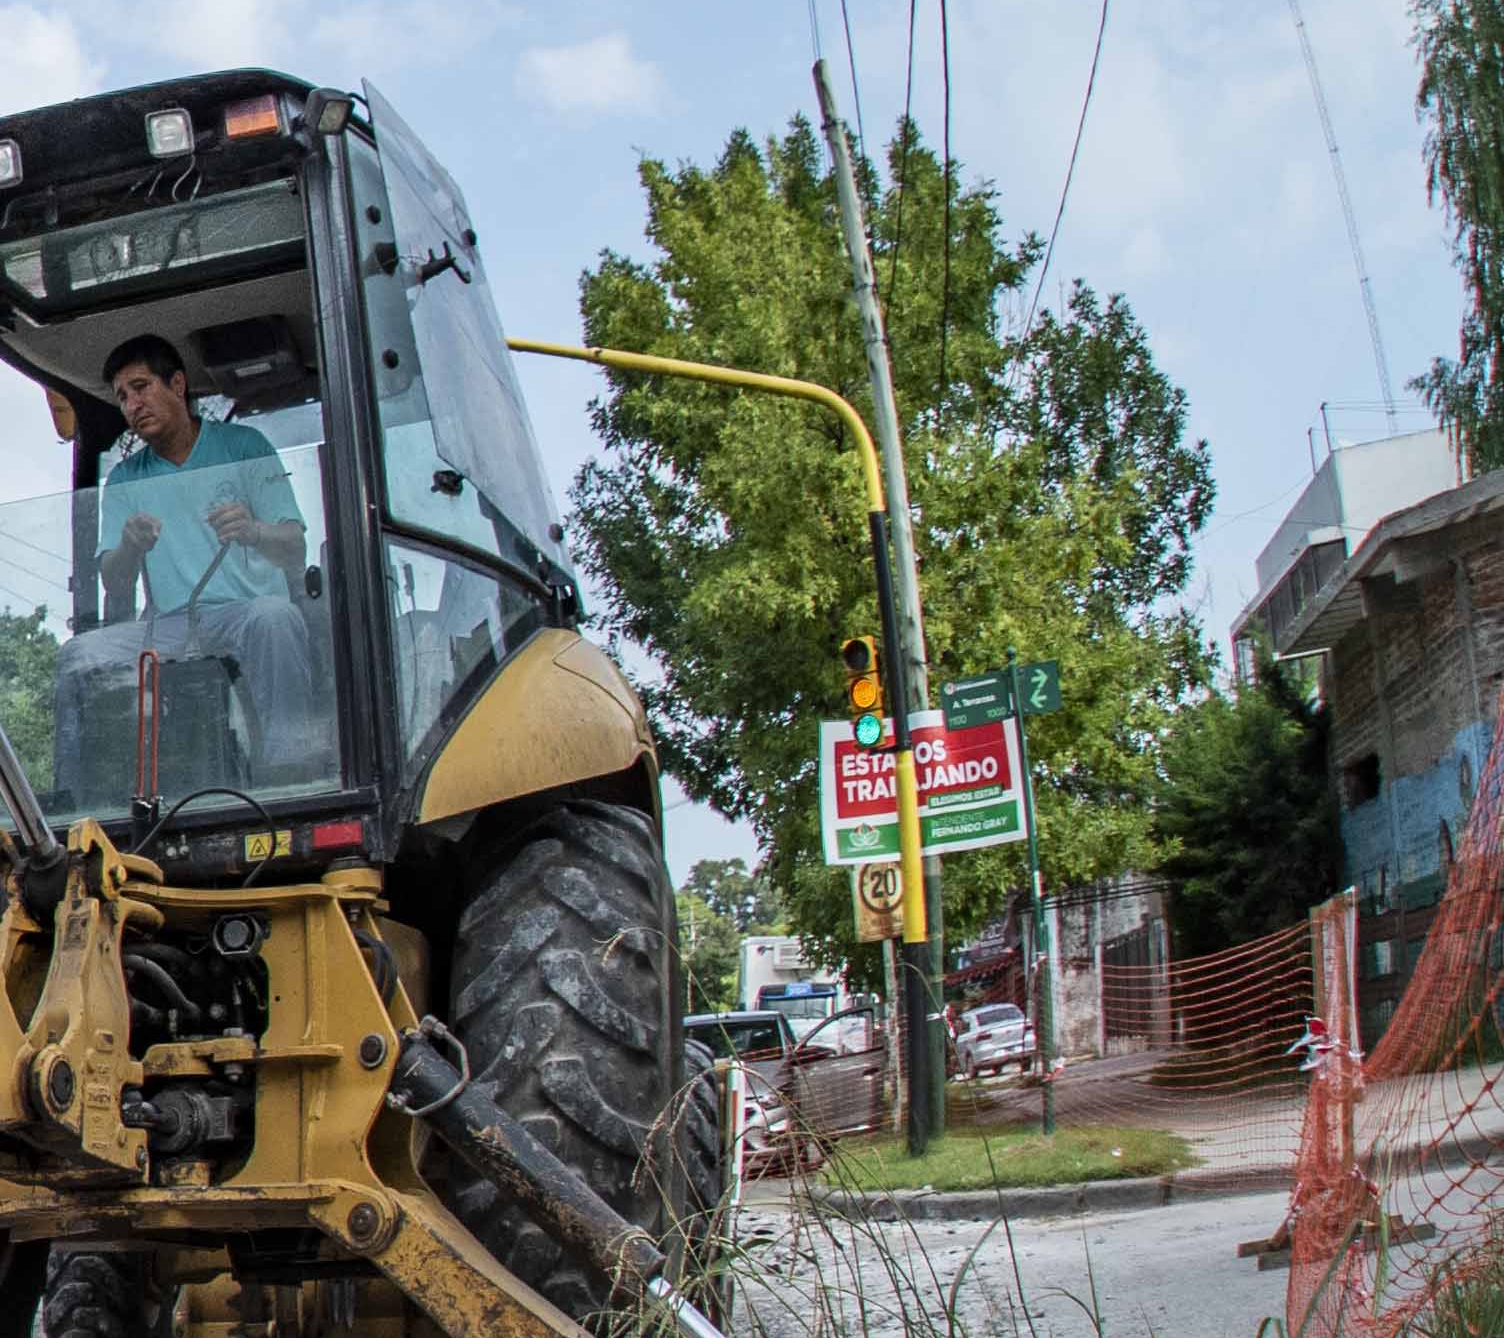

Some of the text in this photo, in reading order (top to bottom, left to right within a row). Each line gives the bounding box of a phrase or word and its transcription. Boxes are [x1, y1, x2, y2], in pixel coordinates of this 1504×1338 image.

[841, 739, 948, 776] ESTAOS
[842, 756, 998, 803] TRAJANDO
[870, 867, 897, 898] 20
